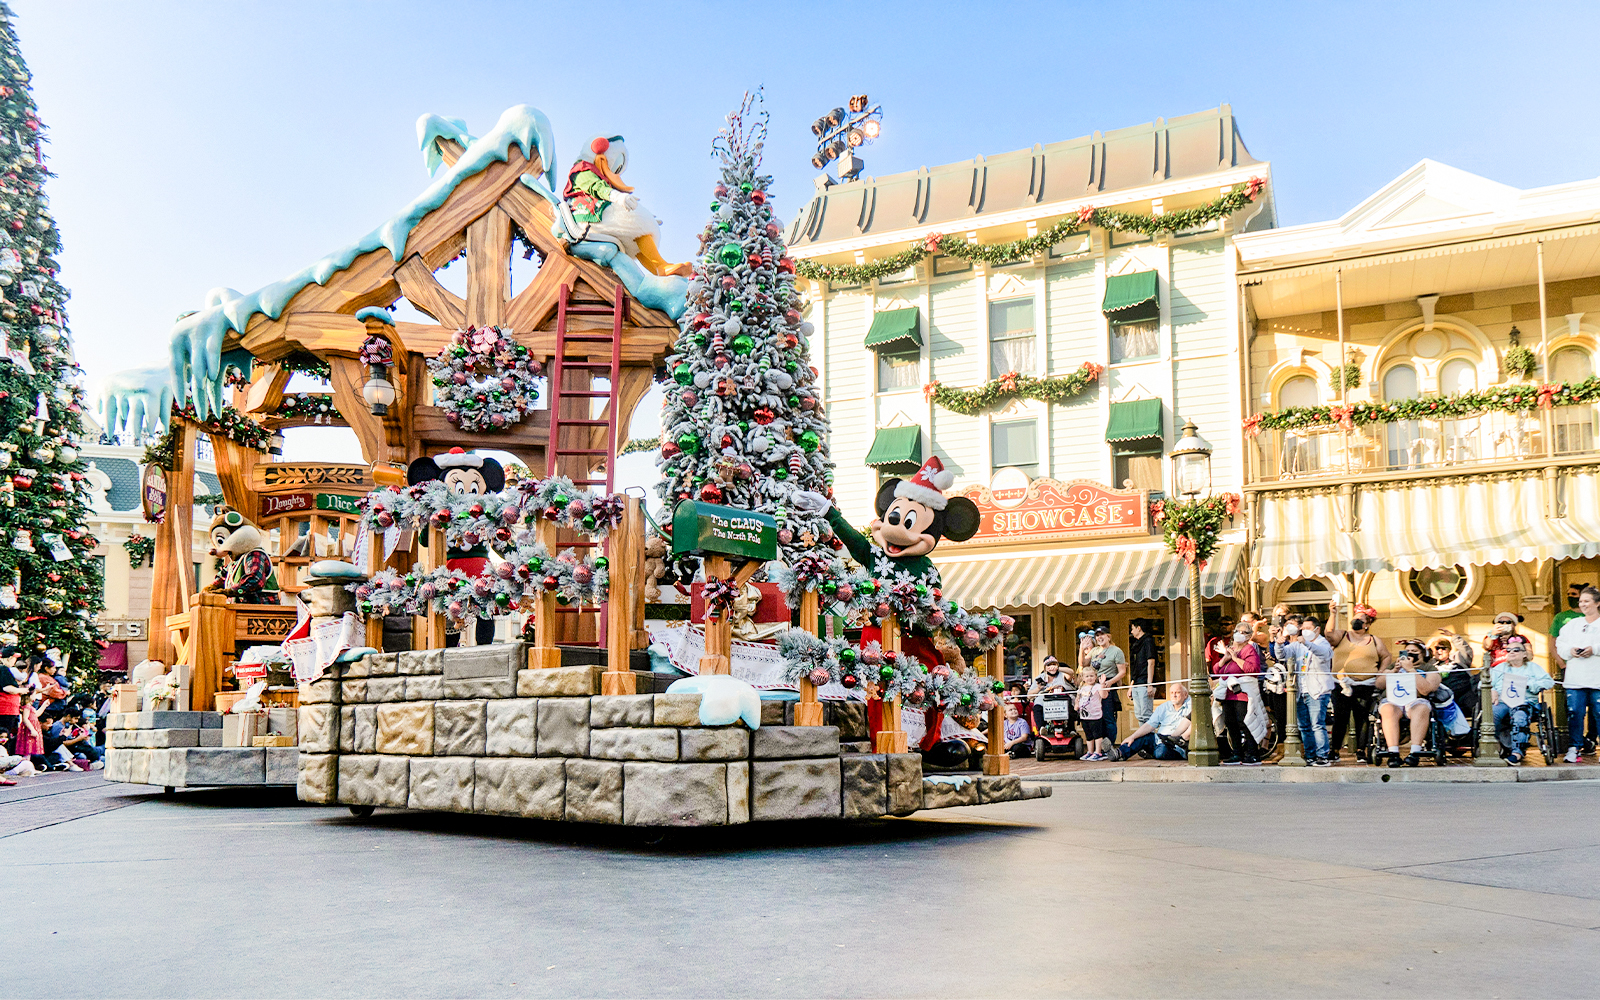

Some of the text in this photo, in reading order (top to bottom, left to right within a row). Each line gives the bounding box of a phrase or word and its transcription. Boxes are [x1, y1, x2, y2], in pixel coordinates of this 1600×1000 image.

[266, 495, 306, 514] Naughty
[326, 494, 352, 511] Nice
[710, 513, 729, 528] The
[993, 504, 1123, 532] SHOWCASE
[712, 527, 761, 544] The North Pole
